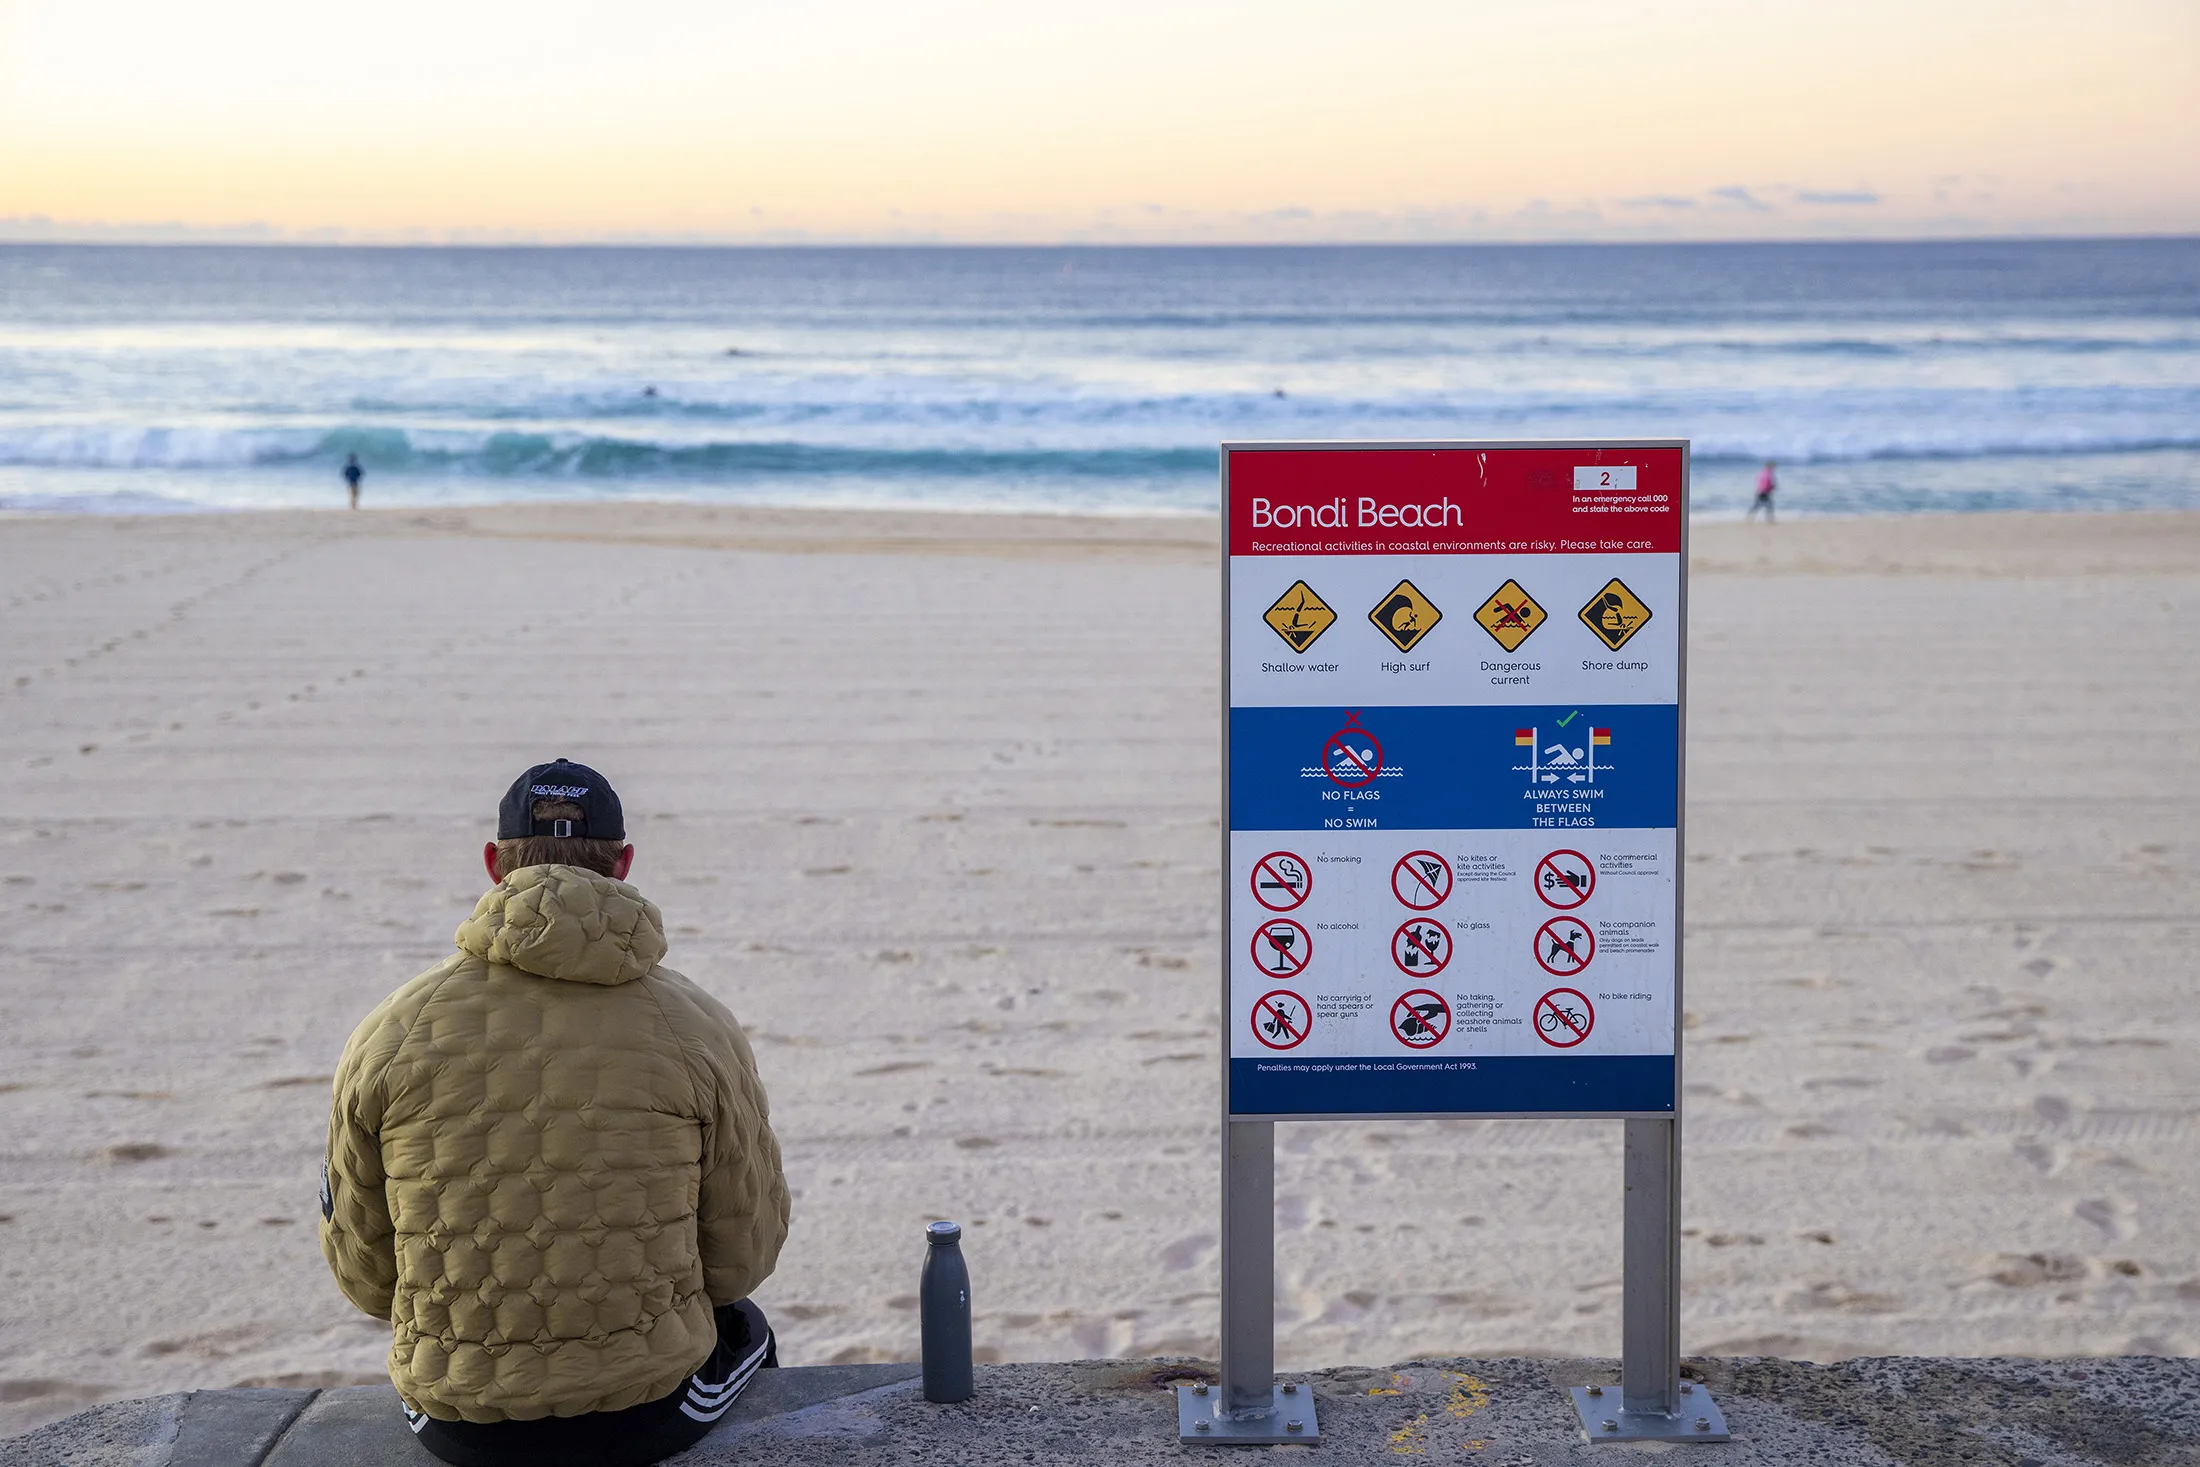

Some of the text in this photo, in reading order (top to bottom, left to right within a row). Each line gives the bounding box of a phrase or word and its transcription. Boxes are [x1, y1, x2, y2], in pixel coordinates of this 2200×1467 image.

[1600, 472, 1610, 486] 2
[1594, 496, 1636, 504] emergency
[1253, 497, 1463, 528] Bondi Beach
[1253, 542, 1322, 551] Recreational
[1325, 541, 1372, 551] activities
[1376, 541, 1385, 550] in
[1389, 541, 1430, 550] coastal
[1433, 540, 1506, 550] environments
[1531, 540, 1556, 551] risky.
[1561, 540, 1596, 549] Please
[1600, 540, 1623, 549] take
[1262, 663, 1339, 672] Shallow water
[1382, 662, 1430, 674] High surf
[1480, 661, 1540, 673] Dangerous
[1582, 660, 1648, 673] Shore dump
[1491, 676, 1529, 684] current
[1322, 791, 1380, 800] NO FLAGS
[1524, 790, 1603, 799] ALWAYS SWIM
[1537, 804, 1590, 812] BETWEEN
[1325, 819, 1376, 828] NO SWIM
[1532, 817, 1594, 826] THE FLAGS
[1331, 856, 1361, 865] smoking
[1330, 995, 1361, 1003] carrying
[1630, 993, 1651, 1001] riding
